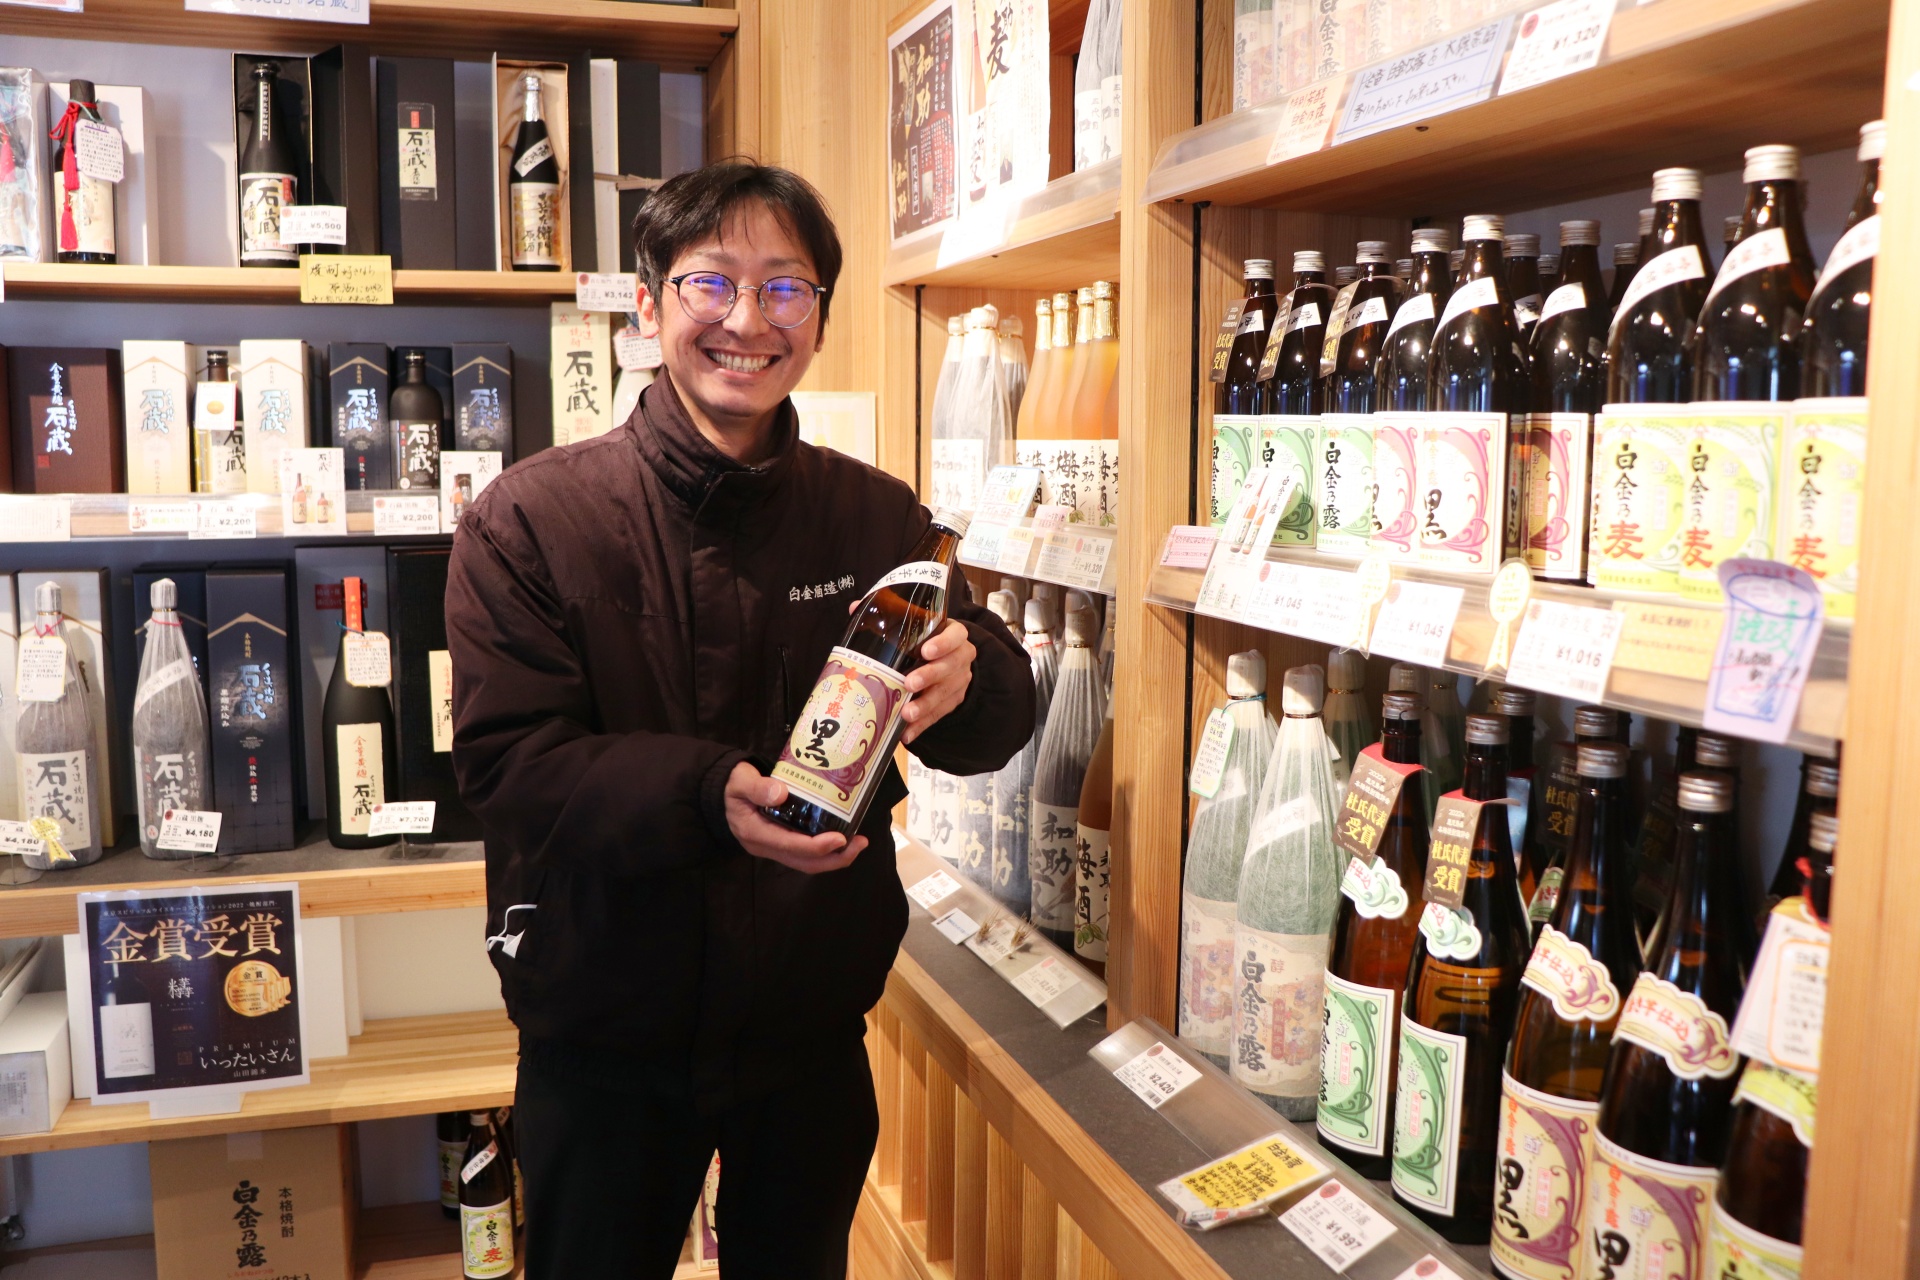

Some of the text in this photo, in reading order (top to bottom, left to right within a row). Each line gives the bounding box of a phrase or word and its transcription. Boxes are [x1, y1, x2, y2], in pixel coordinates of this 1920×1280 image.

[1552, 24, 1601, 51] ¥1,320
[406, 131, 427, 169] 石蔵
[310, 222, 342, 231] ¥5,500
[603, 290, 634, 299] ¥3,142
[564, 350, 600, 416] 石蔵
[44, 406, 73, 456] 石蔵
[140, 388, 169, 434] 石蔵
[259, 388, 287, 434] 石蔵
[346, 388, 373, 433] 石蔵
[469, 388, 495, 431] 石蔵
[407, 423, 434, 474] 石蔵
[1322, 441, 1342, 529] 白金乃露
[1604, 443, 1645, 561] 白金乃麦
[1683, 444, 1714, 569] 白金乃麦
[219, 518, 251, 527] ¥2,200
[402, 513, 434, 522] ¥2,200
[1420, 488, 1447, 542] 黒
[1790, 444, 1828, 579] 白金乃麦
[789, 574, 855, 602] 白金酒造(株)
[1274, 595, 1303, 611] ¥1,045
[1408, 619, 1446, 639] ¥1,045
[1556, 643, 1603, 669] ¥1,016
[238, 664, 266, 720] 石蔵
[825, 666, 859, 719] 白金乃露
[795, 718, 841, 769] 黒
[36, 759, 75, 825] 石蔵
[153, 753, 189, 818] 石蔵
[353, 784, 373, 817] 石蔵
[1345, 791, 1389, 829] 杜氏代表
[5, 835, 41, 845] ¥4,180
[185, 829, 215, 838] ¥4,180
[1039, 811, 1075, 877] 和助
[1344, 816, 1377, 850] 受賞
[1431, 839, 1470, 867] 杜氏代表
[1432, 865, 1463, 894] 受賞
[101, 912, 284, 964] 金賞受賞
[1237, 949, 1267, 1072] 白金乃露
[199, 1038, 296, 1053] PREMIUM
[200, 1047, 296, 1069] いったいさん
[1149, 1072, 1176, 1095] ¥2,420
[232, 1180, 267, 1269] 白金乃露
[278, 1187, 295, 1238] 本格焼酎
[1326, 1219, 1363, 1250] ¥1,997
[482, 1219, 504, 1264] 白金乃麦
